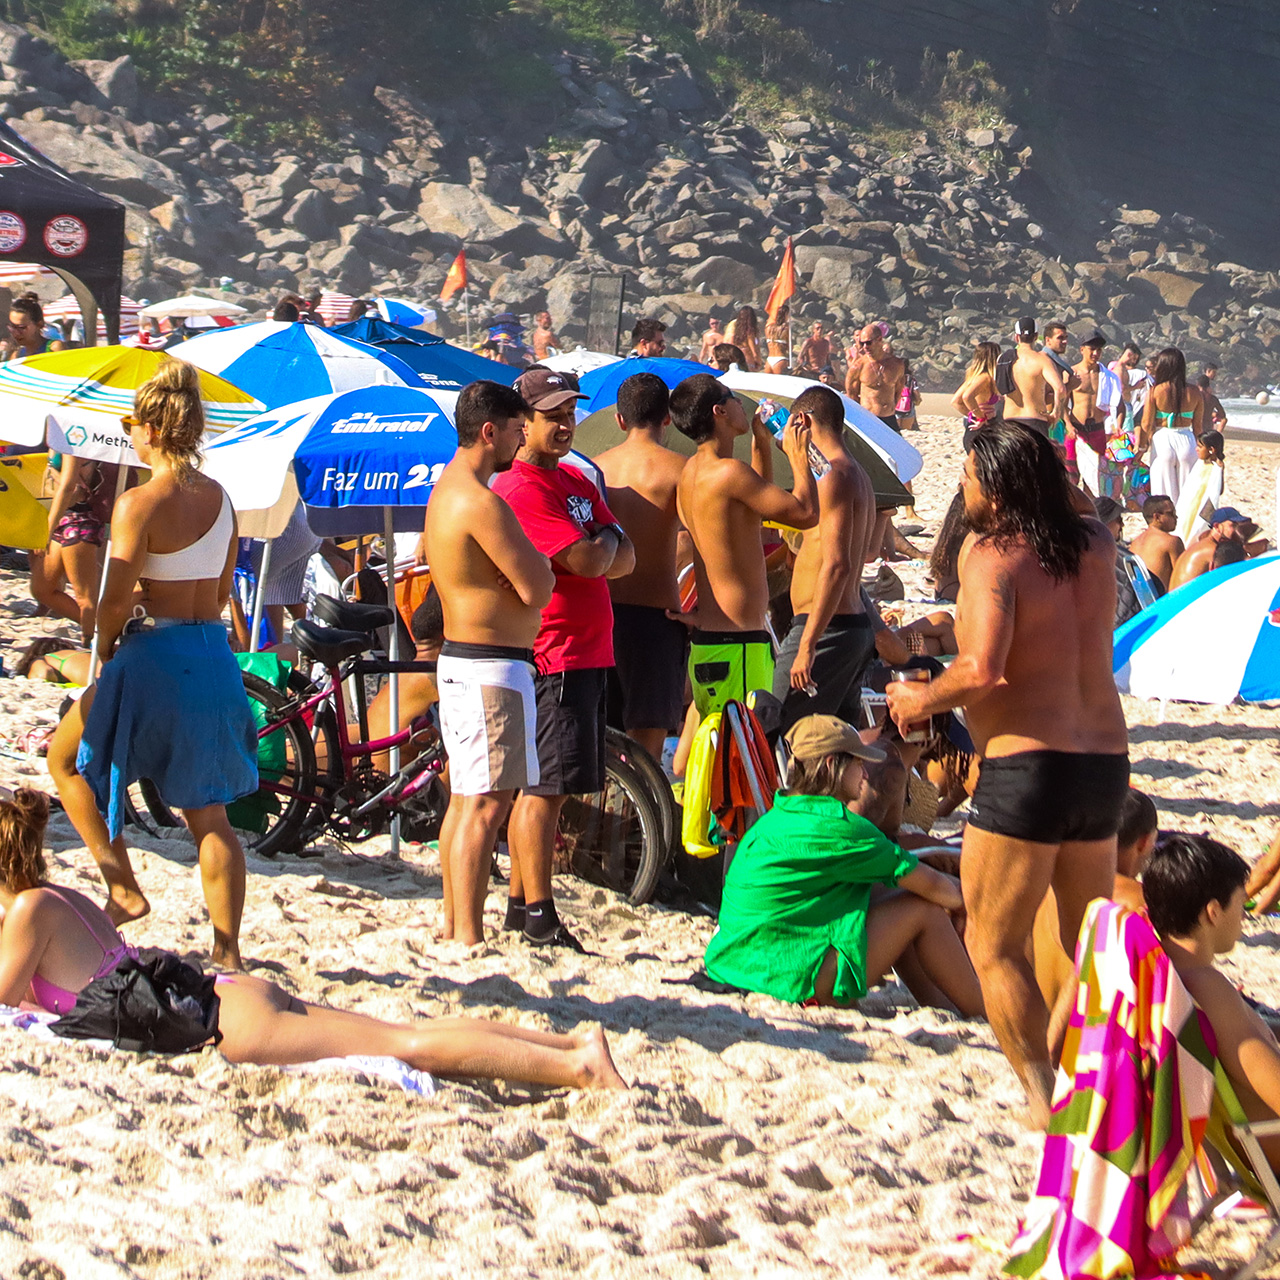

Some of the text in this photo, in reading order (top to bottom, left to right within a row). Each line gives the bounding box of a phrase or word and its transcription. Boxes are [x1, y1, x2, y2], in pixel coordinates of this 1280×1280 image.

[424, 379, 463, 387] ona
[350, 412, 374, 421] 21
[322, 463, 446, 491] Faz um 21
